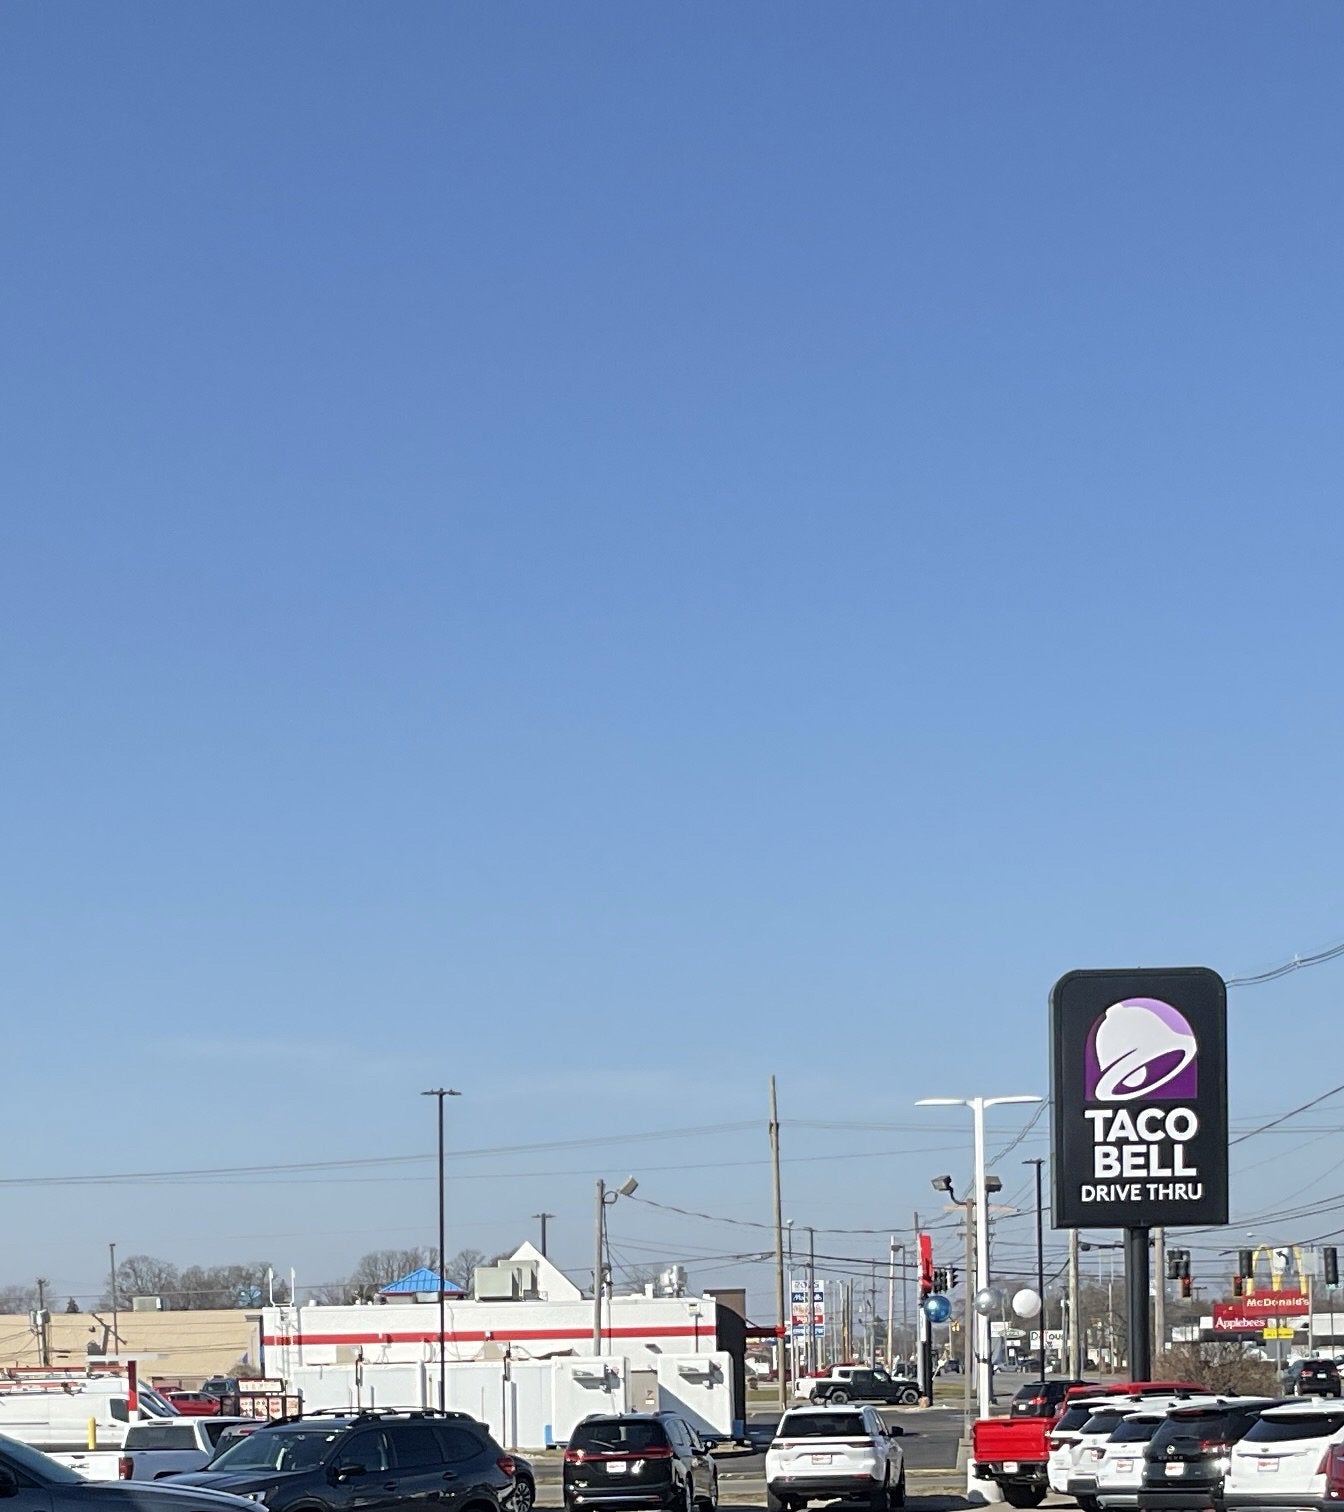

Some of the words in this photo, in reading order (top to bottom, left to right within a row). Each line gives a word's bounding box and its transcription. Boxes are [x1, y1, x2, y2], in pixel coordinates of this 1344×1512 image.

[1084, 1107, 1198, 1142] TACO
[1094, 1144, 1197, 1178] BELL
[1081, 1184, 1142, 1202] DRIVE
[1146, 1183, 1203, 1201] THRU
[1246, 1297, 1309, 1307] McDonald's
